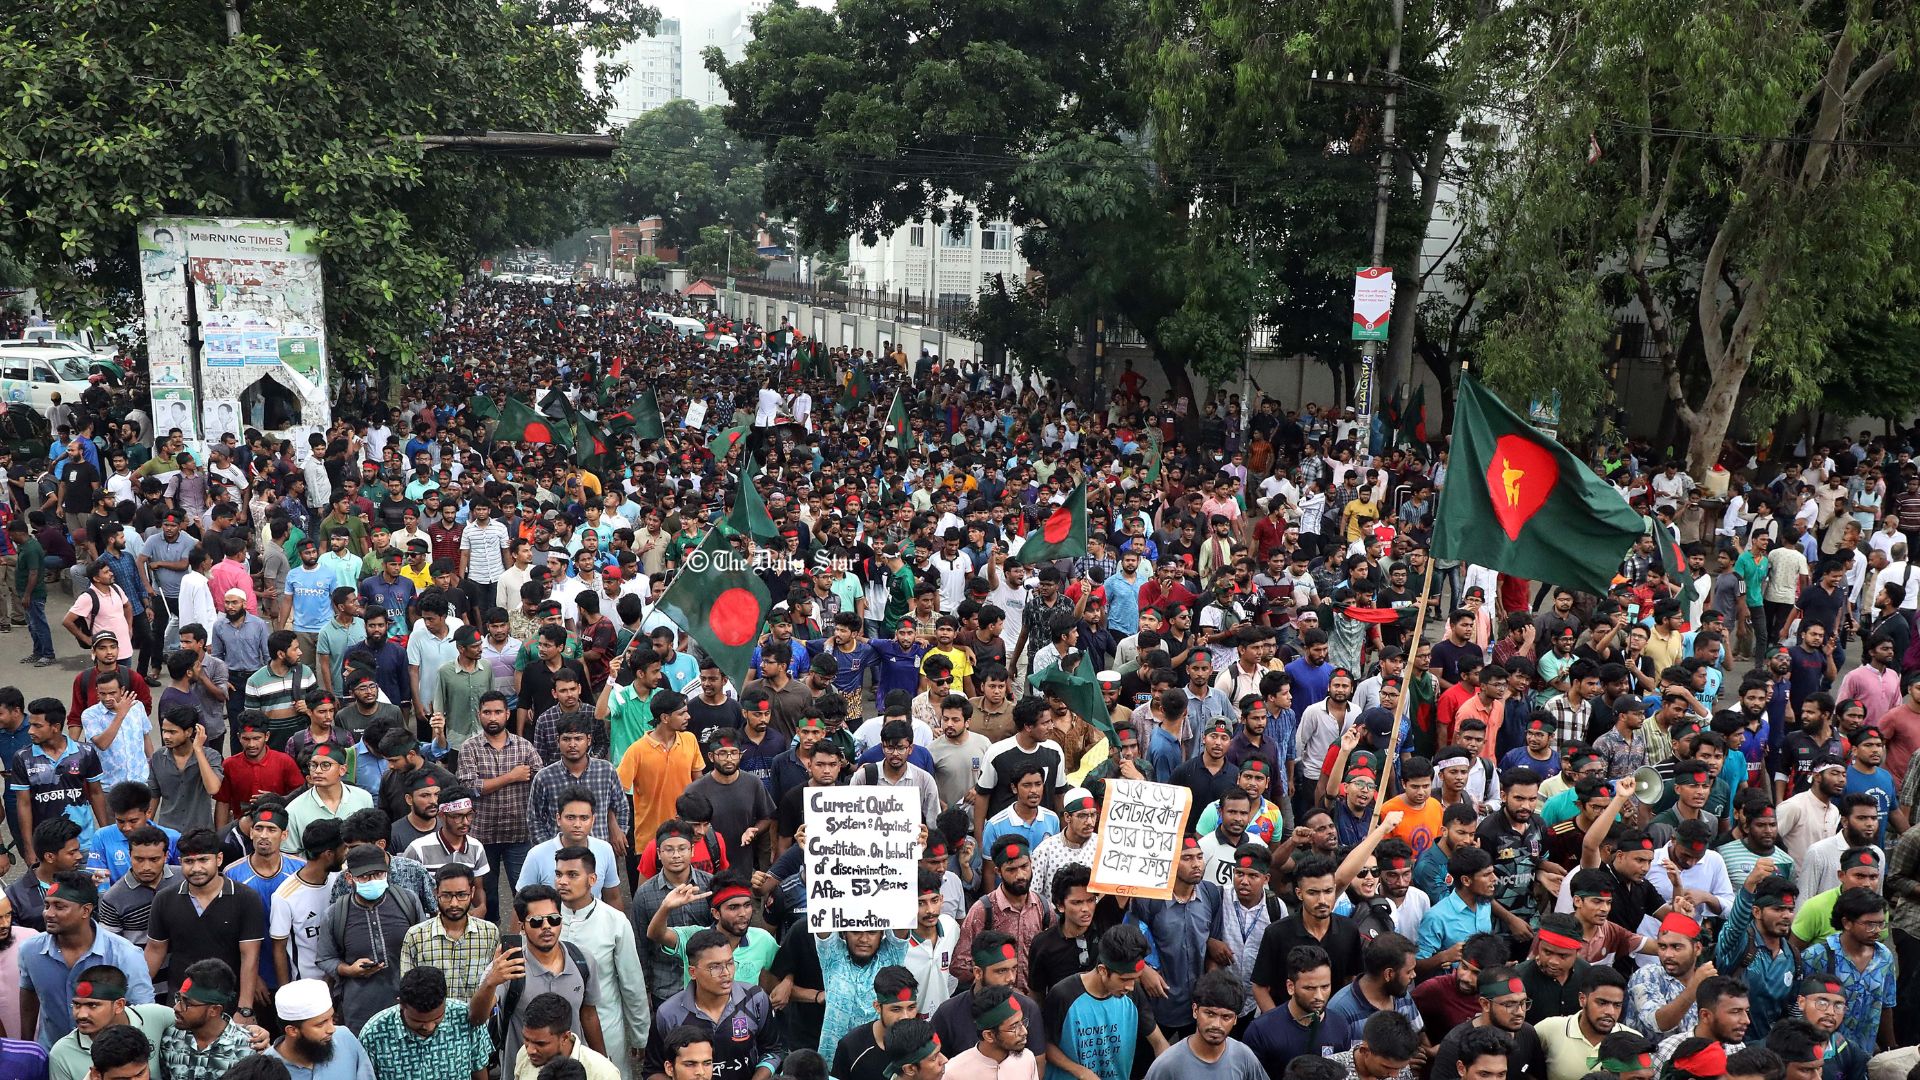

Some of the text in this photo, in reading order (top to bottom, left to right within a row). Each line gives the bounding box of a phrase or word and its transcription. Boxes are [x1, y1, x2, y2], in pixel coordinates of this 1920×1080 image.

[190, 232, 283, 245] MORNING TIMES
[810, 792, 905, 815] Current Quota
[1110, 799, 1183, 827] কোটার বাঁশ
[873, 816, 913, 837] Against
[1108, 824, 1176, 851] তার উপর
[870, 842, 884, 858] On
[885, 841, 917, 860] behalf
[814, 857, 829, 875] of
[810, 878, 909, 899] After 53 Years
[810, 907, 891, 928] of liberation
[1077, 1023, 1118, 1037] MONEY IS
[1112, 1046, 1120, 1054] IT
